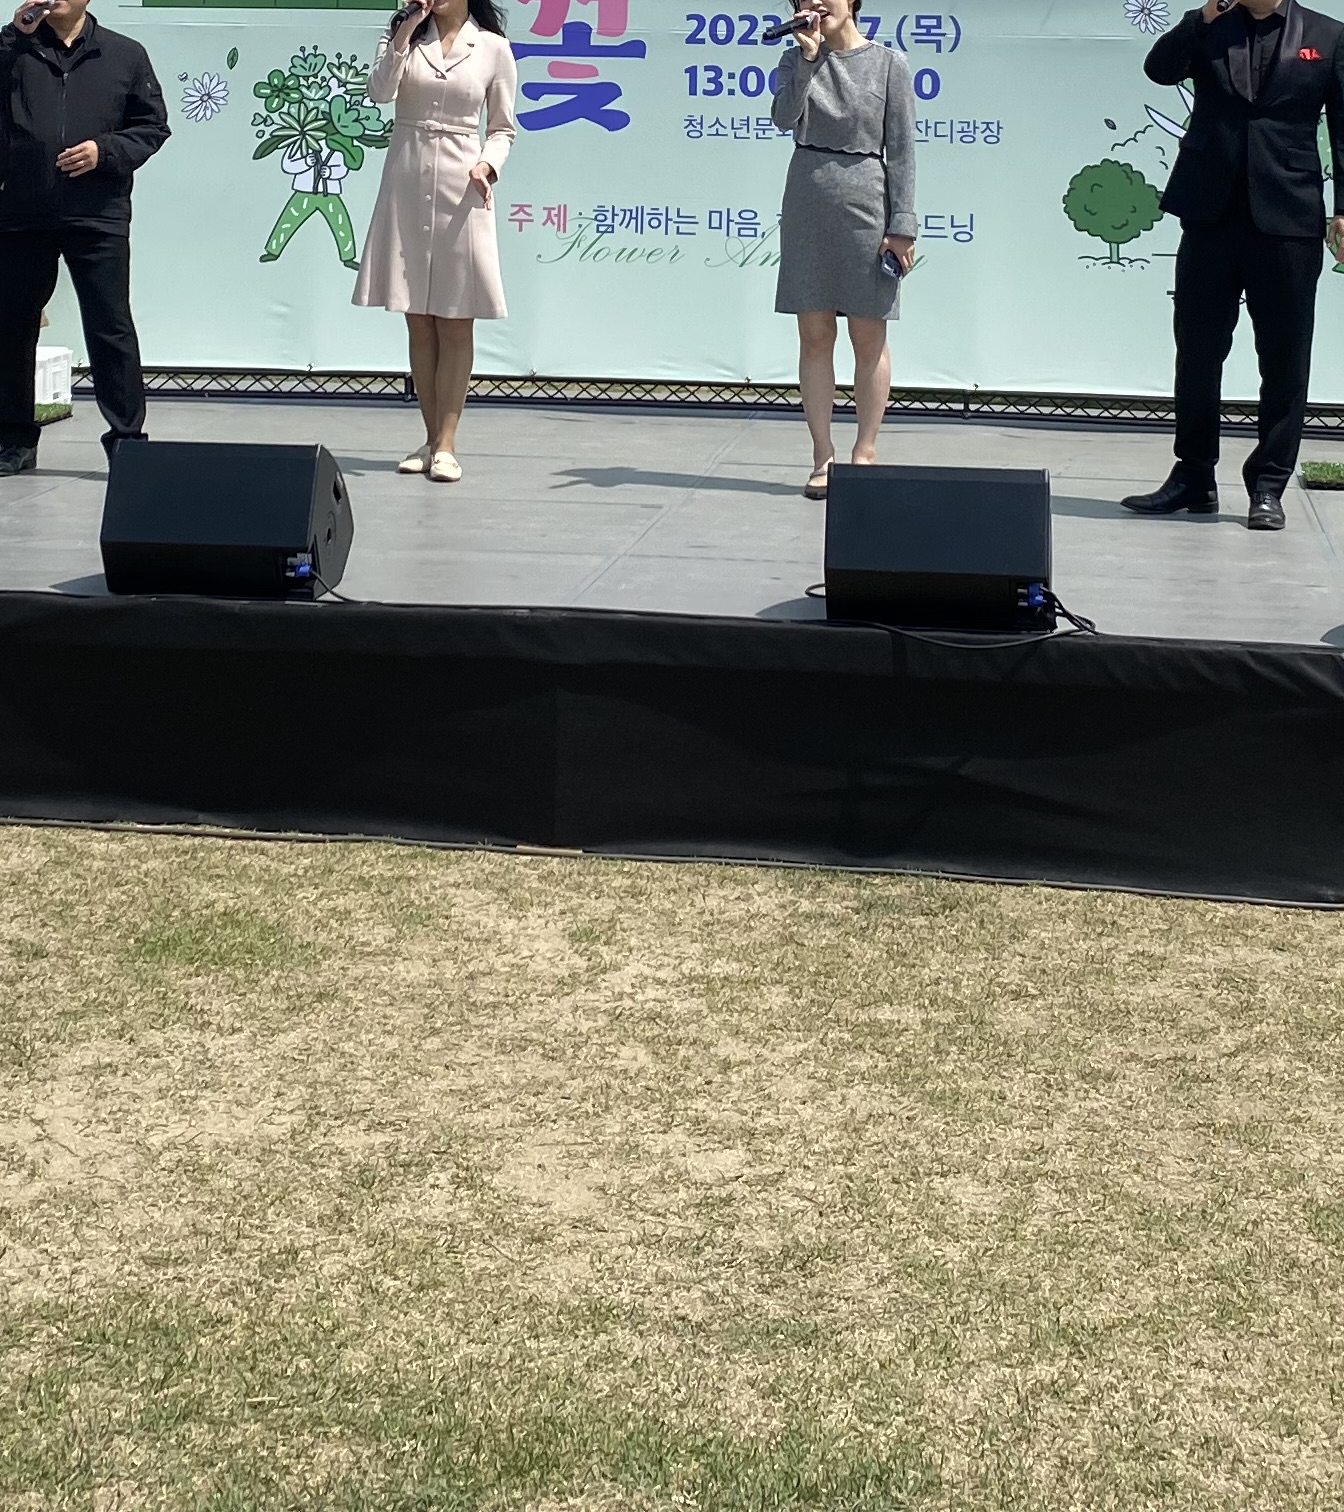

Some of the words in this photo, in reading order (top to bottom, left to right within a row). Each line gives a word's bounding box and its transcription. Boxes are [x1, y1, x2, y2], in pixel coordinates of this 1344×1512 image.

[535, 217, 685, 265] Flower
[592, 204, 699, 236] 함께하는
[708, 207, 767, 239] 마음,
